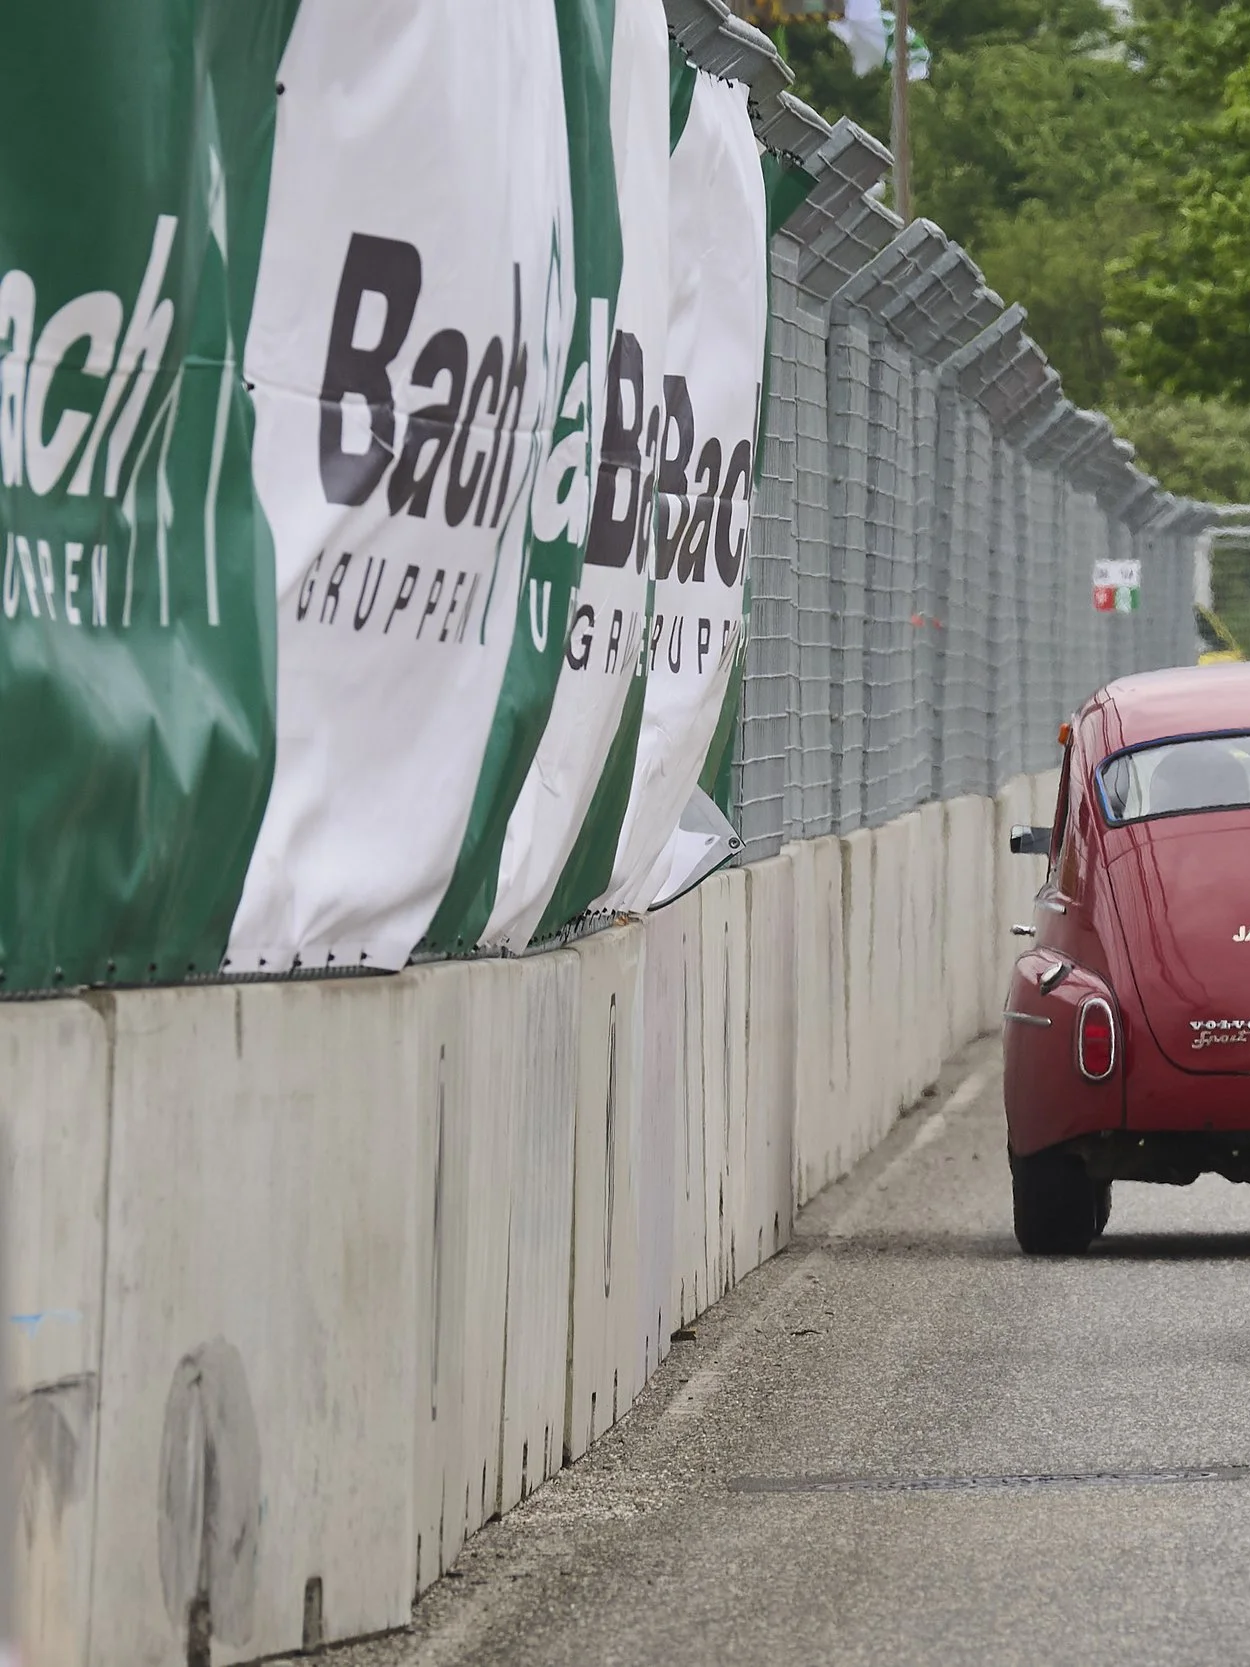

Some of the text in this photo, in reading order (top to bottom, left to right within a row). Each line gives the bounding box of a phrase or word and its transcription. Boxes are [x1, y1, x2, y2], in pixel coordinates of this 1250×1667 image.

[318, 231, 528, 529] Bach
[654, 374, 760, 588] Bac
[296, 548, 482, 645] GRUPPEN
